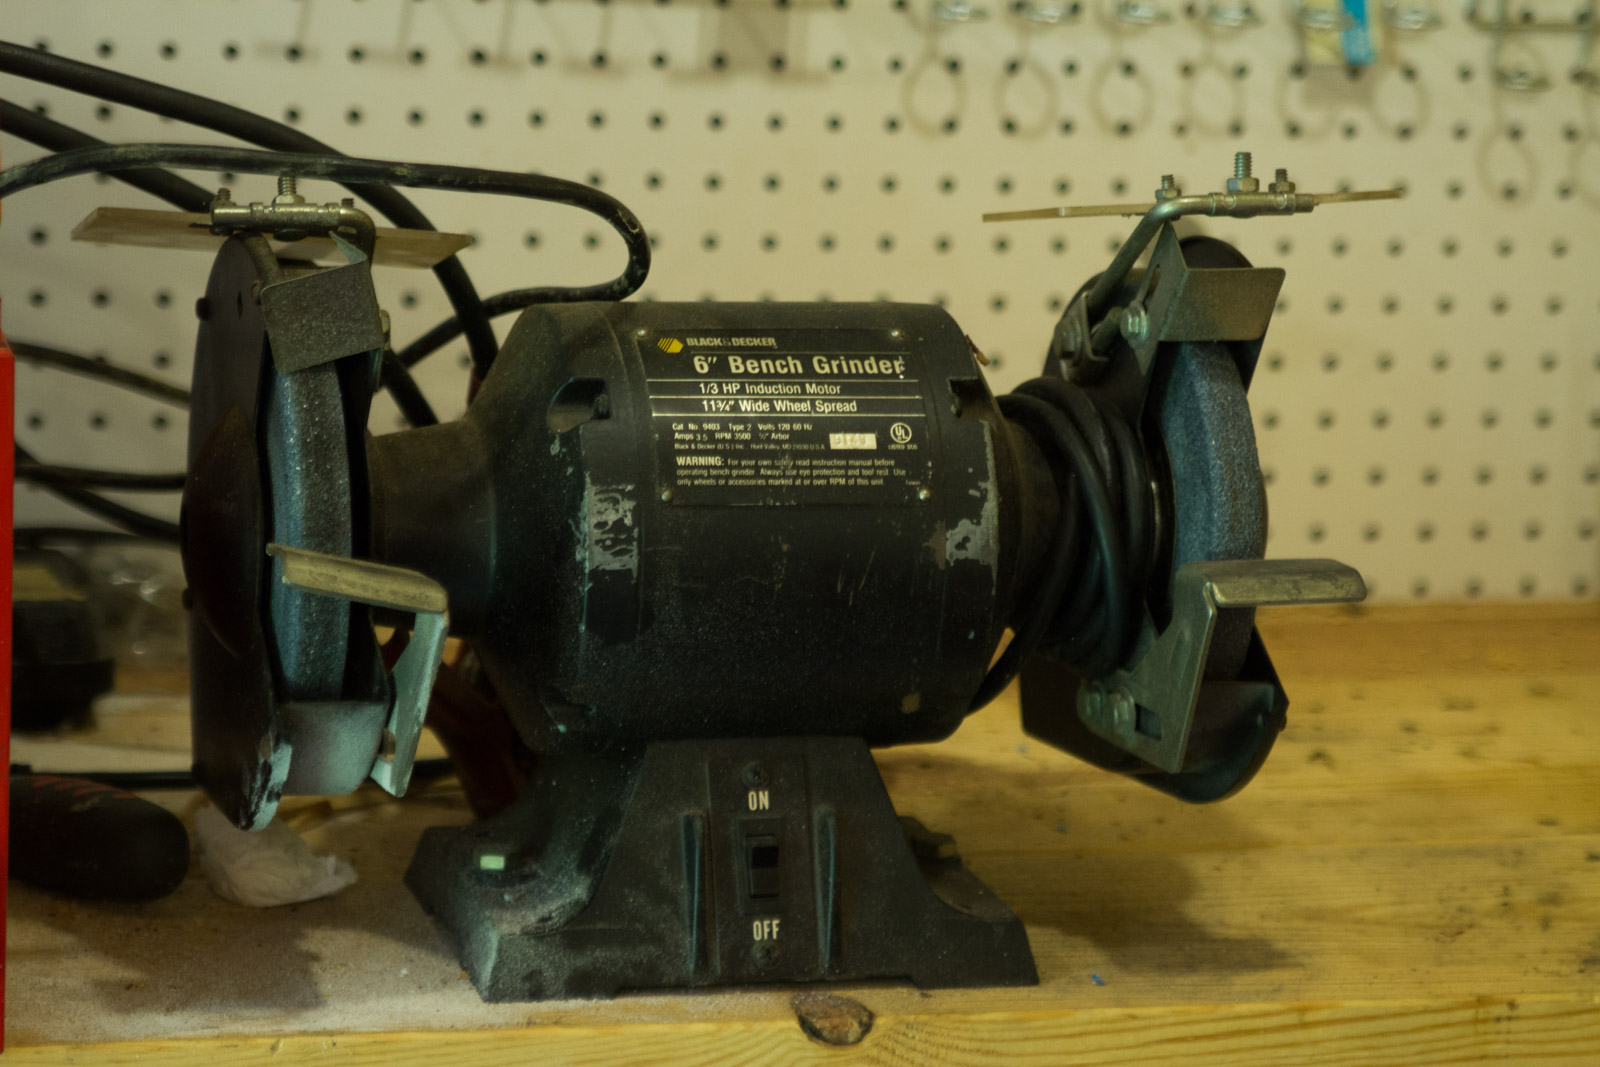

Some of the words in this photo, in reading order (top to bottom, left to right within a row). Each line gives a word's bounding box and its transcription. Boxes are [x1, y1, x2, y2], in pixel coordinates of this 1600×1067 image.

[693, 355, 717, 374] 6"
[728, 355, 803, 374] Bench
[812, 355, 903, 374] Grinder
[699, 383, 719, 394] 1/3
[722, 383, 740, 394] HP
[745, 383, 801, 394] Induction
[805, 383, 841, 394] Motor
[739, 400, 770, 412] Wide
[773, 400, 811, 412] Wheel
[815, 400, 857, 414] Spread
[702, 423, 720, 431] 9403
[728, 423, 745, 432] Type
[746, 423, 752, 431] 2
[757, 423, 775, 431] Volts
[777, 423, 790, 431] 120
[792, 423, 802, 431] 60
[803, 423, 813, 431] Hz
[674, 432, 694, 441] Amps
[714, 432, 732, 440] RPM
[734, 432, 752, 440] 3500
[771, 432, 790, 440] Arbor
[676, 456, 724, 466] WARNING:
[741, 460, 756, 468] your
[677, 468, 708, 477] operating
[760, 468, 783, 477] Always
[812, 468, 846, 477] protection
[677, 478, 691, 487] only
[694, 478, 717, 486] wheels
[768, 478, 793, 486] marked
[829, 478, 845, 486] RPM
[847, 478, 855, 486] of
[857, 478, 870, 486] this
[748, 790, 770, 811] ON
[753, 919, 780, 941] OFF
